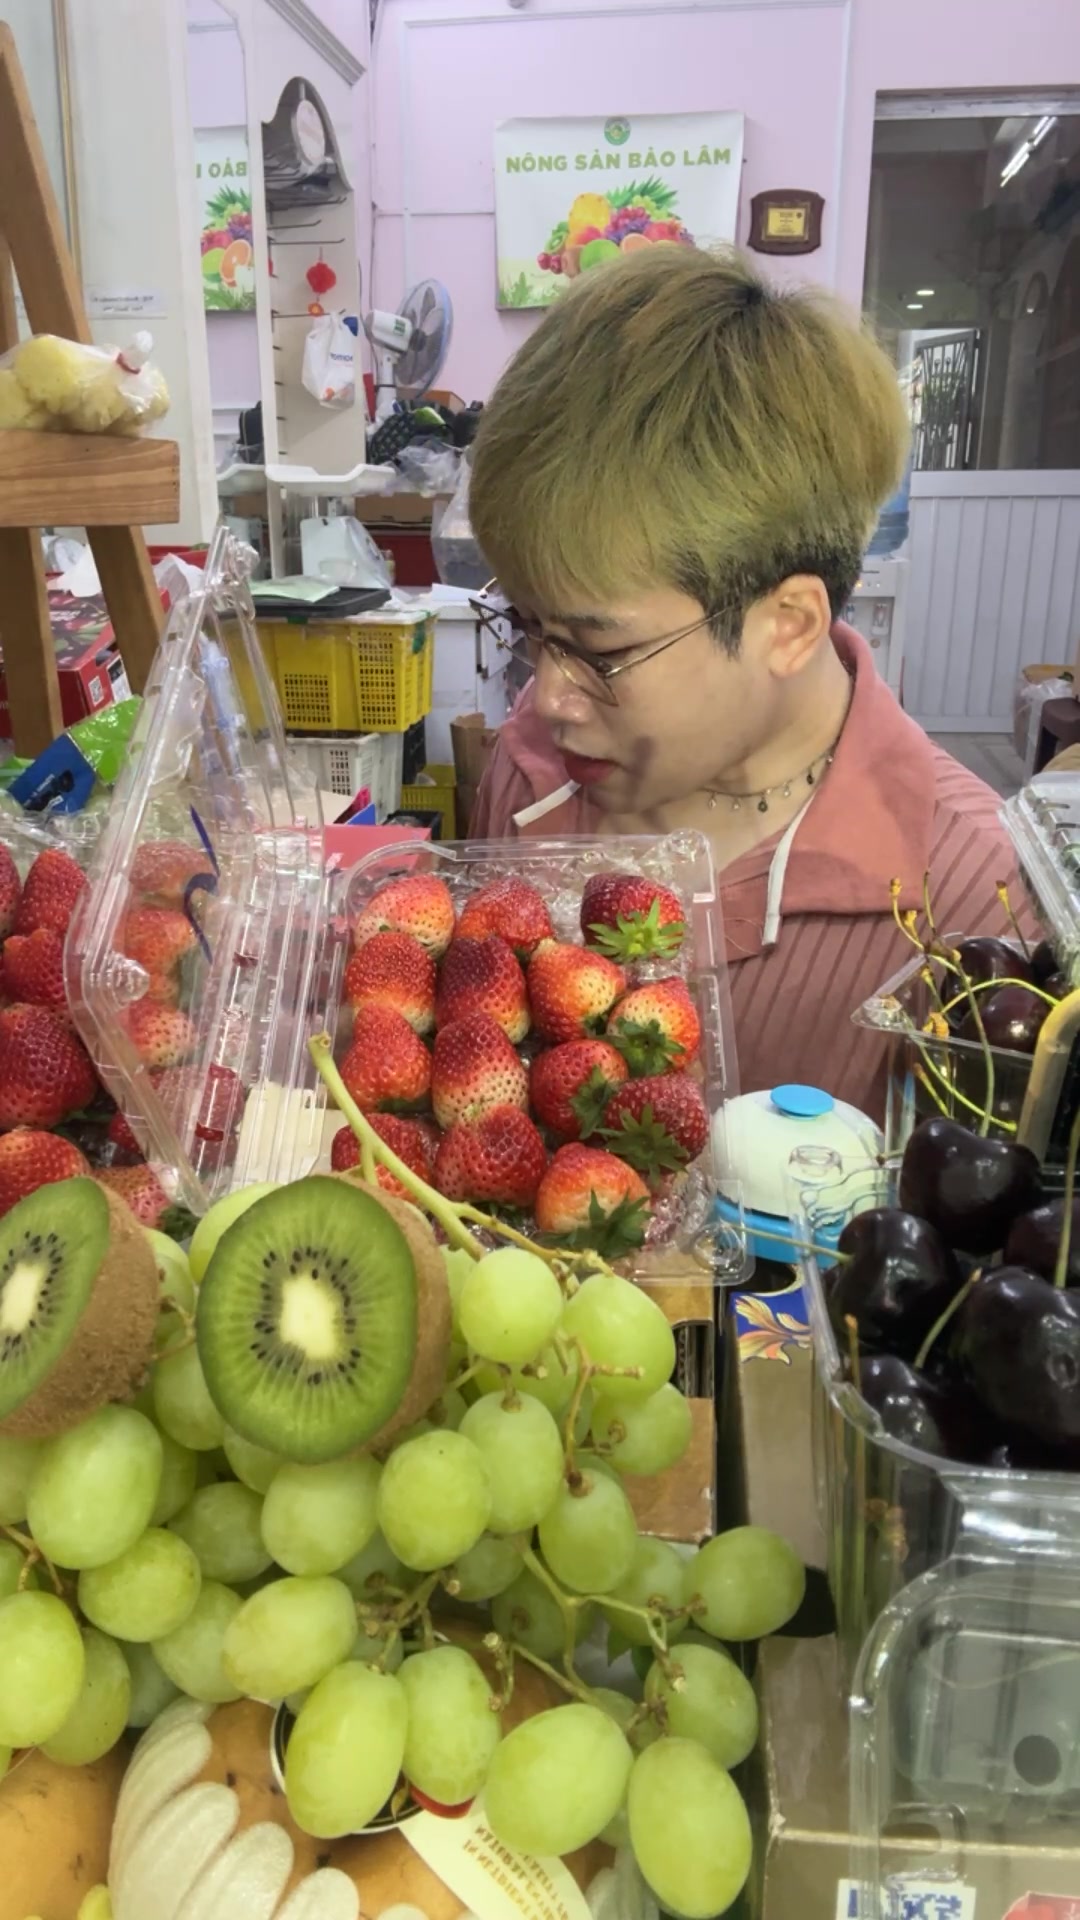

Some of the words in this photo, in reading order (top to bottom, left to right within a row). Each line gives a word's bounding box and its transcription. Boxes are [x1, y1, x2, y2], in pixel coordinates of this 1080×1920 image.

[506, 152, 567, 173] NÔNG
[575, 149, 620, 170] SẢN
[628, 146, 676, 168] BẢO
[683, 144, 731, 166] LÂM
